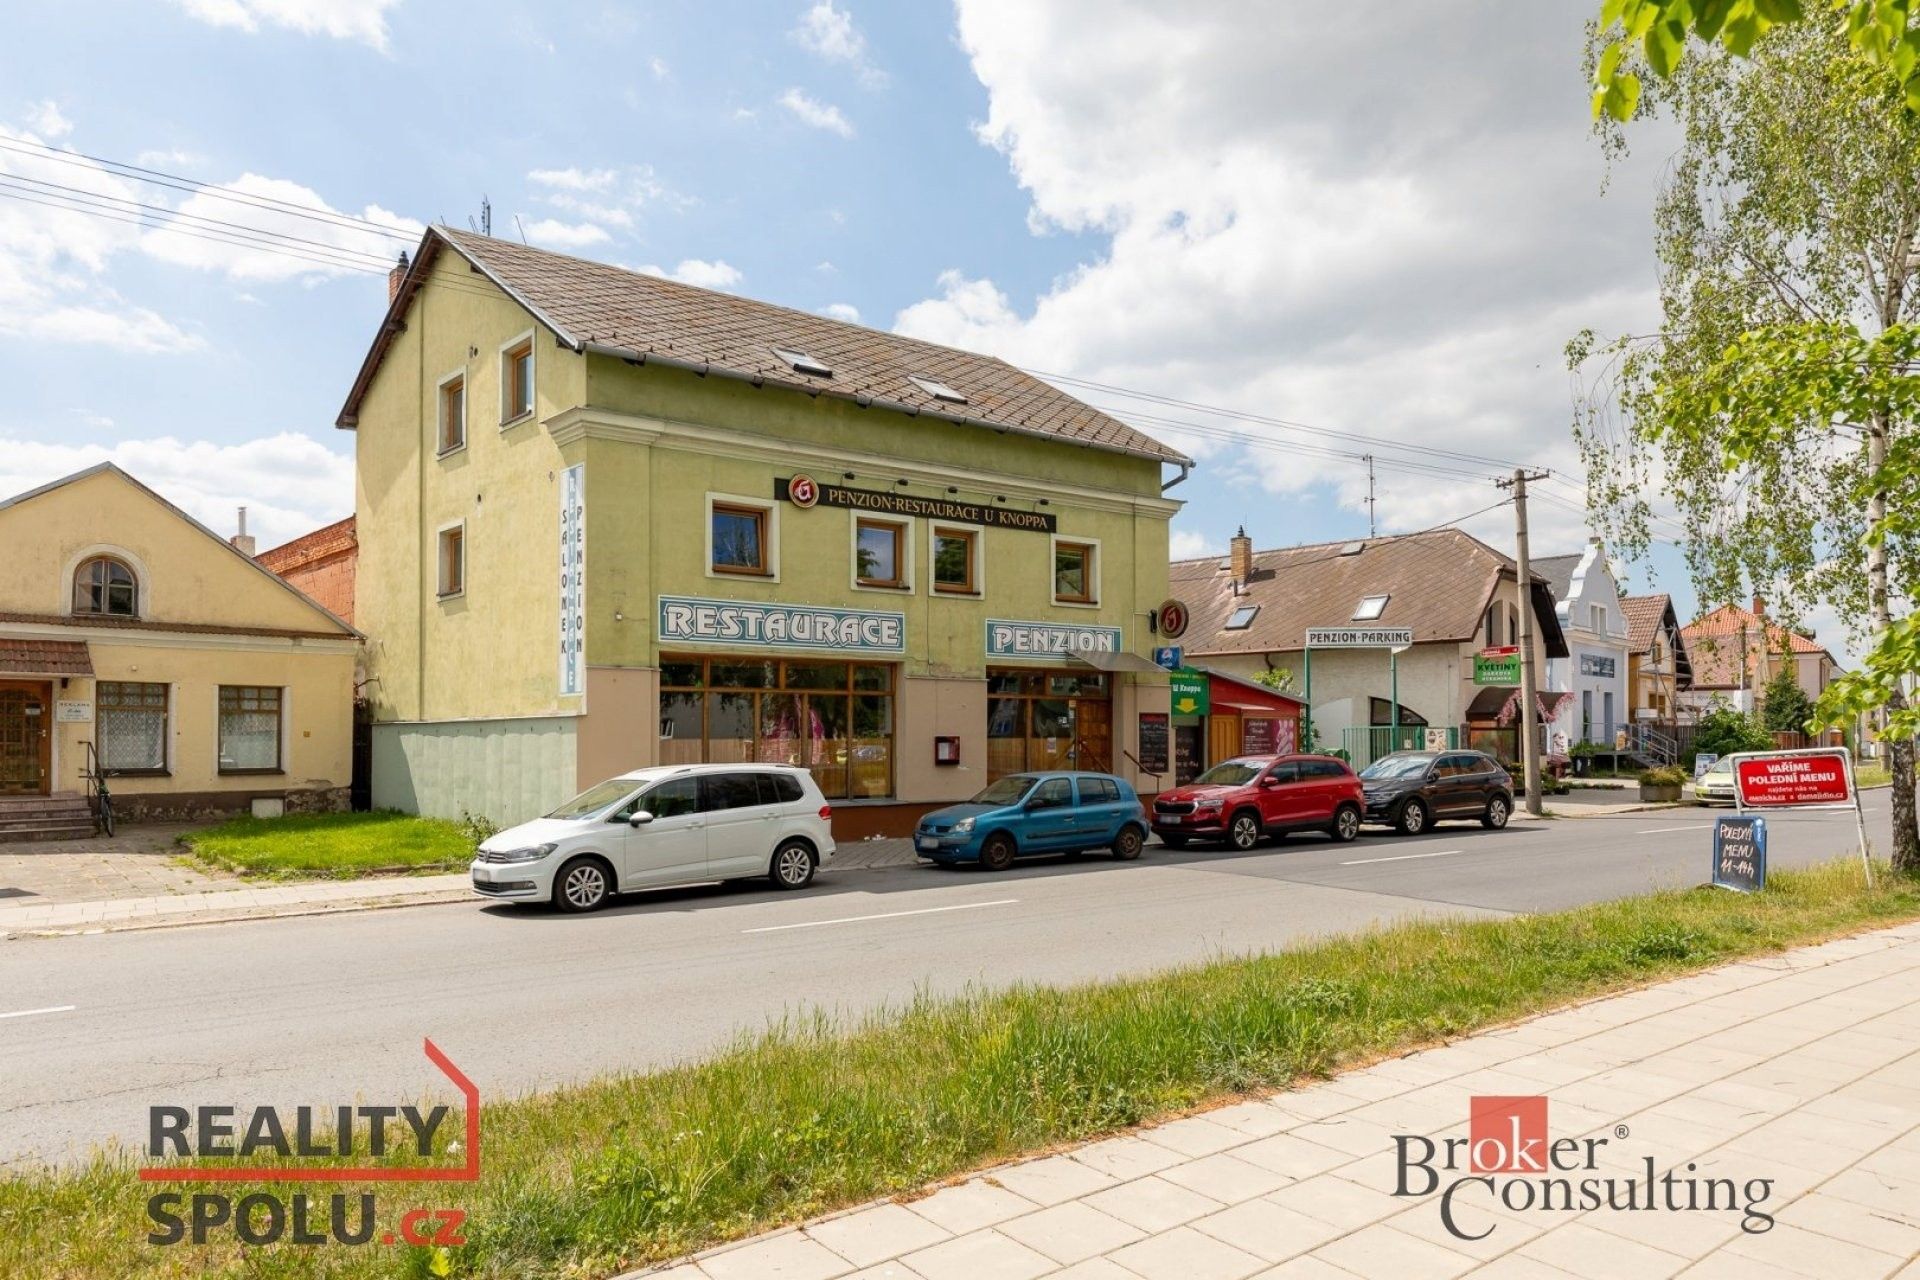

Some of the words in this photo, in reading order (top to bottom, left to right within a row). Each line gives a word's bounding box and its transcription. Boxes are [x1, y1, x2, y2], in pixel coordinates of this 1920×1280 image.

[828, 488, 979, 520] PENZION-RESTAURACE
[984, 509, 994, 522] U
[999, 511, 1048, 529] KNOPPA
[575, 505, 583, 653] PENZION
[664, 603, 899, 646] RESTAURACE
[993, 625, 1115, 654] PENZION
[1748, 772, 1799, 785] POLEDNÍ
[1800, 772, 1836, 782] MENU
[1767, 761, 1812, 774] VAŘÍME
[1723, 844, 1754, 858] MENU
